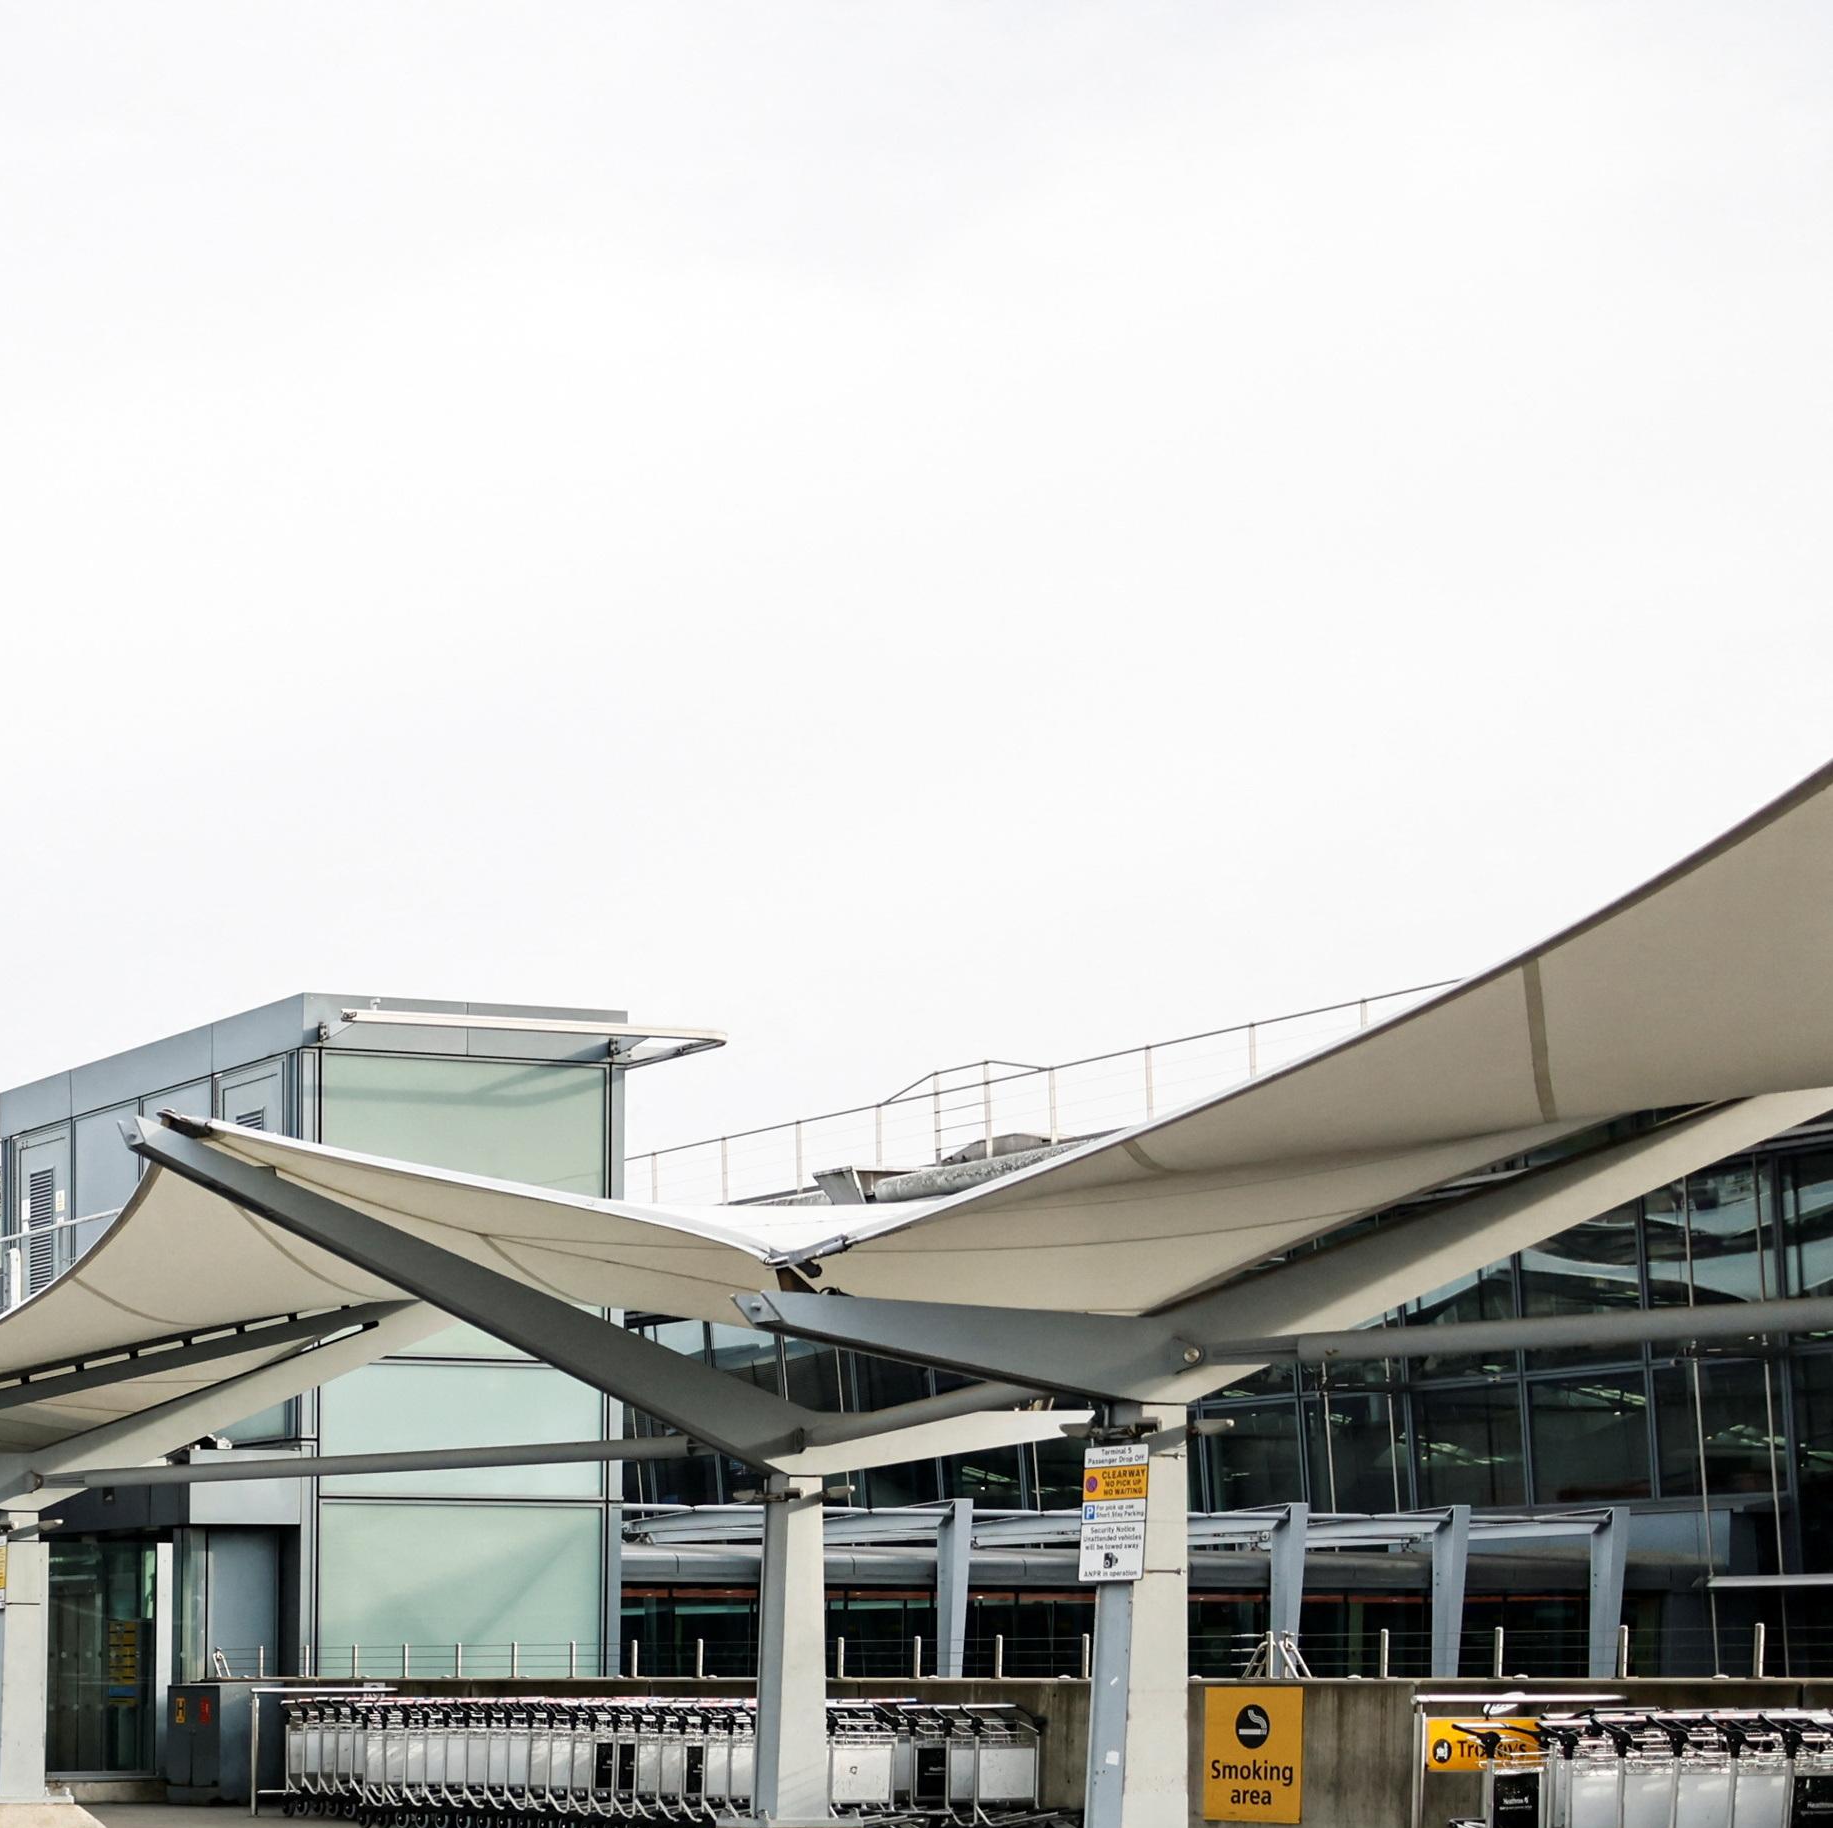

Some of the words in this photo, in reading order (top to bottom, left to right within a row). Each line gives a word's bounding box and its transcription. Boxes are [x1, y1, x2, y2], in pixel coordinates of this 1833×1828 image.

[1102, 1448, 1127, 1456] Terminal
[1102, 1469, 1145, 1480] CLEARWAY
[1116, 1479, 1131, 1487] PICK
[1133, 1478, 1142, 1486] UP
[1115, 1487, 1143, 1495] WAITING
[1091, 1526, 1114, 1534] Security
[1110, 1569, 1137, 1577] operation
[1211, 1760, 1293, 1787] Smoking
[1231, 1789, 1272, 1805] area
